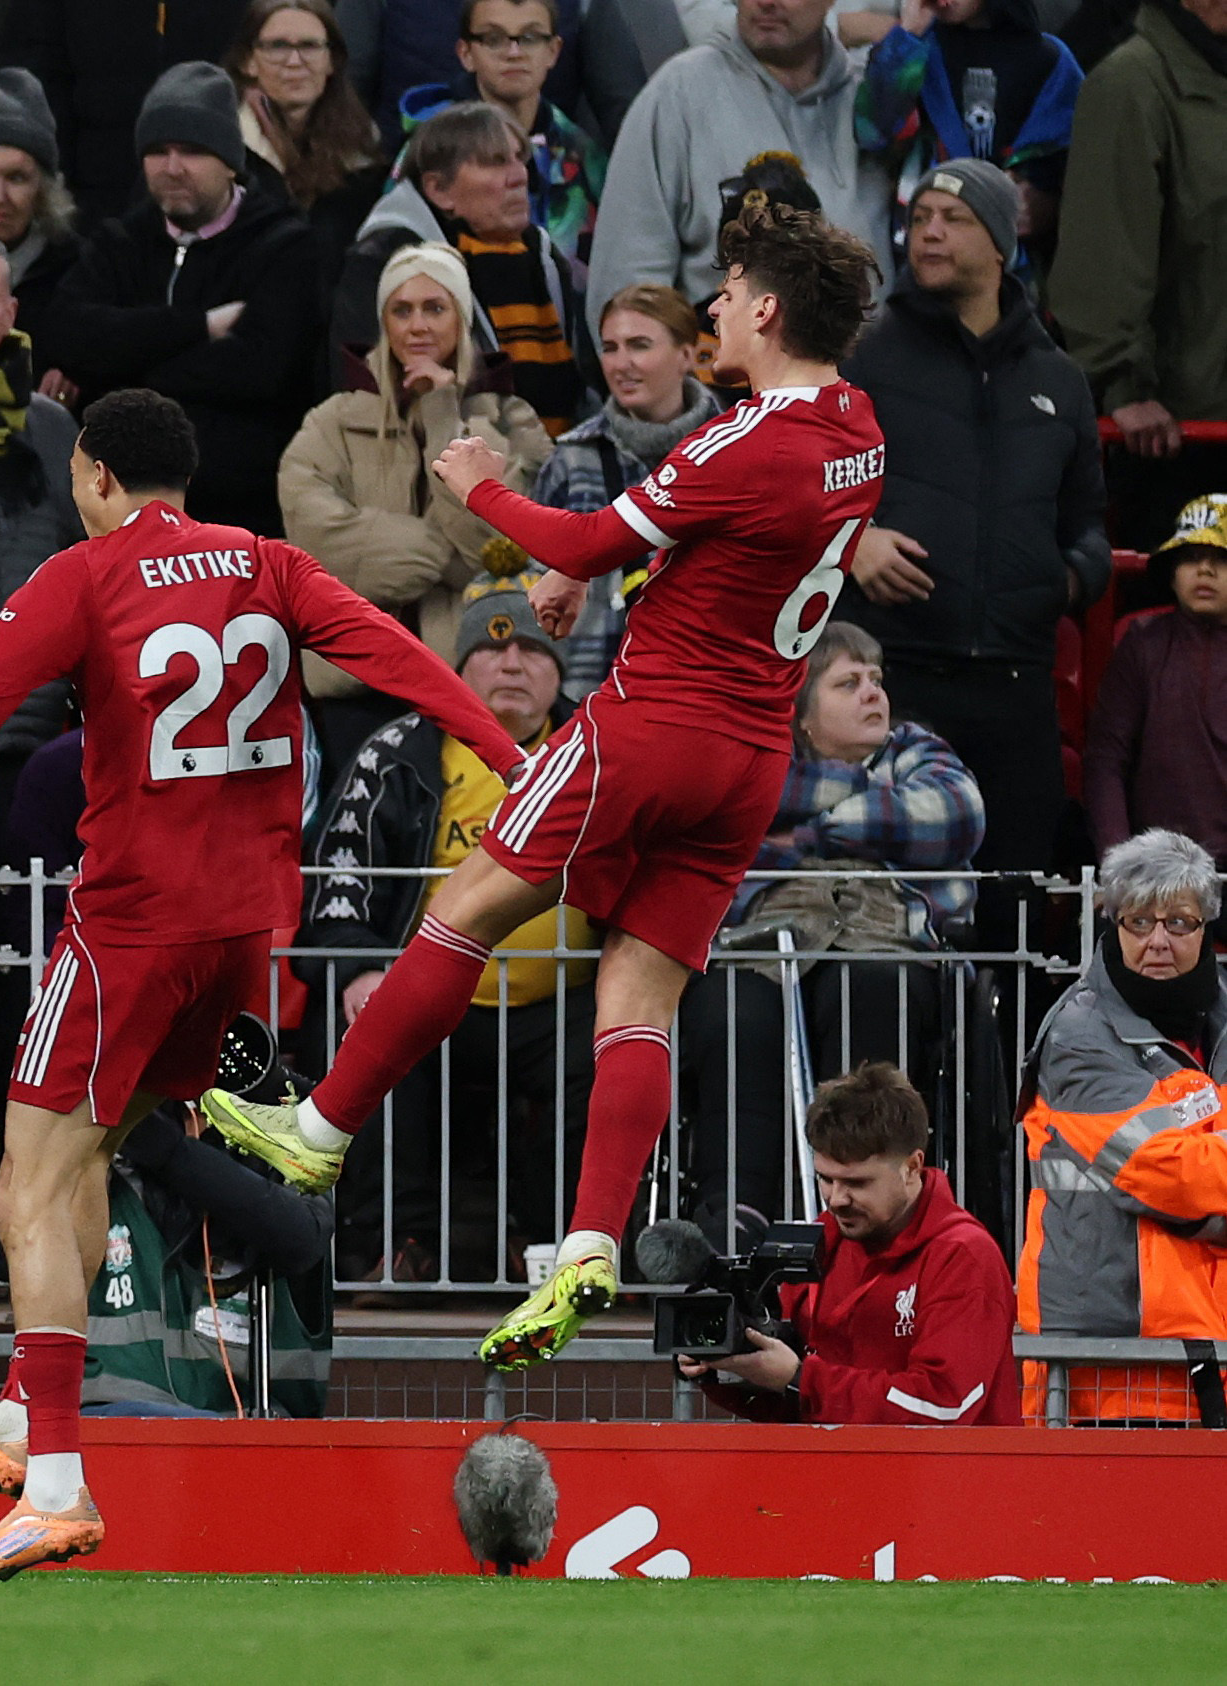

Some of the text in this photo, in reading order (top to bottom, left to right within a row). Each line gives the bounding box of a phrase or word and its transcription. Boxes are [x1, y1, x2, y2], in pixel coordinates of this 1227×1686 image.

[139, 550, 254, 588] EKITIKE
[774, 518, 862, 660] 6
[139, 613, 292, 781] 22
[106, 1274, 135, 1310] 48
